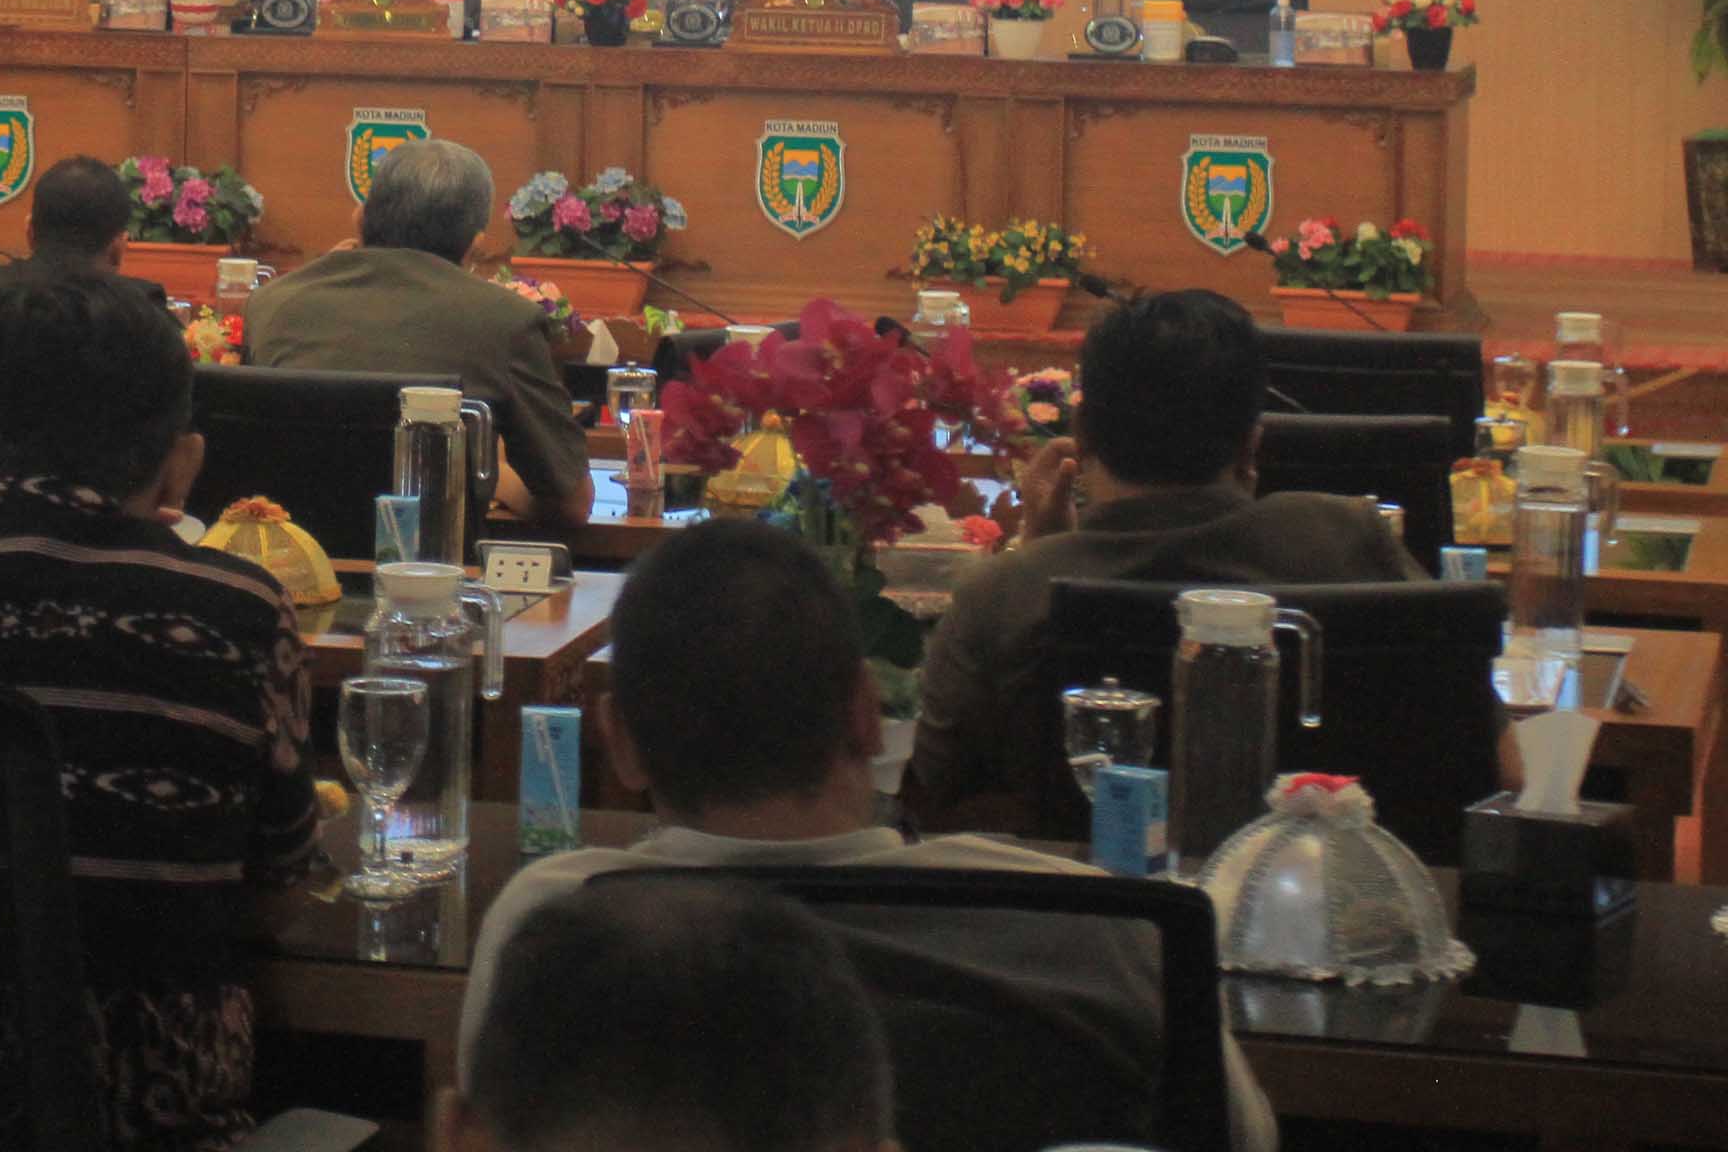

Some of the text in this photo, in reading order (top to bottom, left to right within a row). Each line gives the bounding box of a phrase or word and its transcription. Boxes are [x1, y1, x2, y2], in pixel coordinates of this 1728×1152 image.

[749, 16, 790, 33] WAKIL
[791, 16, 832, 34] KETUA
[384, 111, 424, 121] MADIUN
[767, 122, 837, 133] KOTA MADIUN
